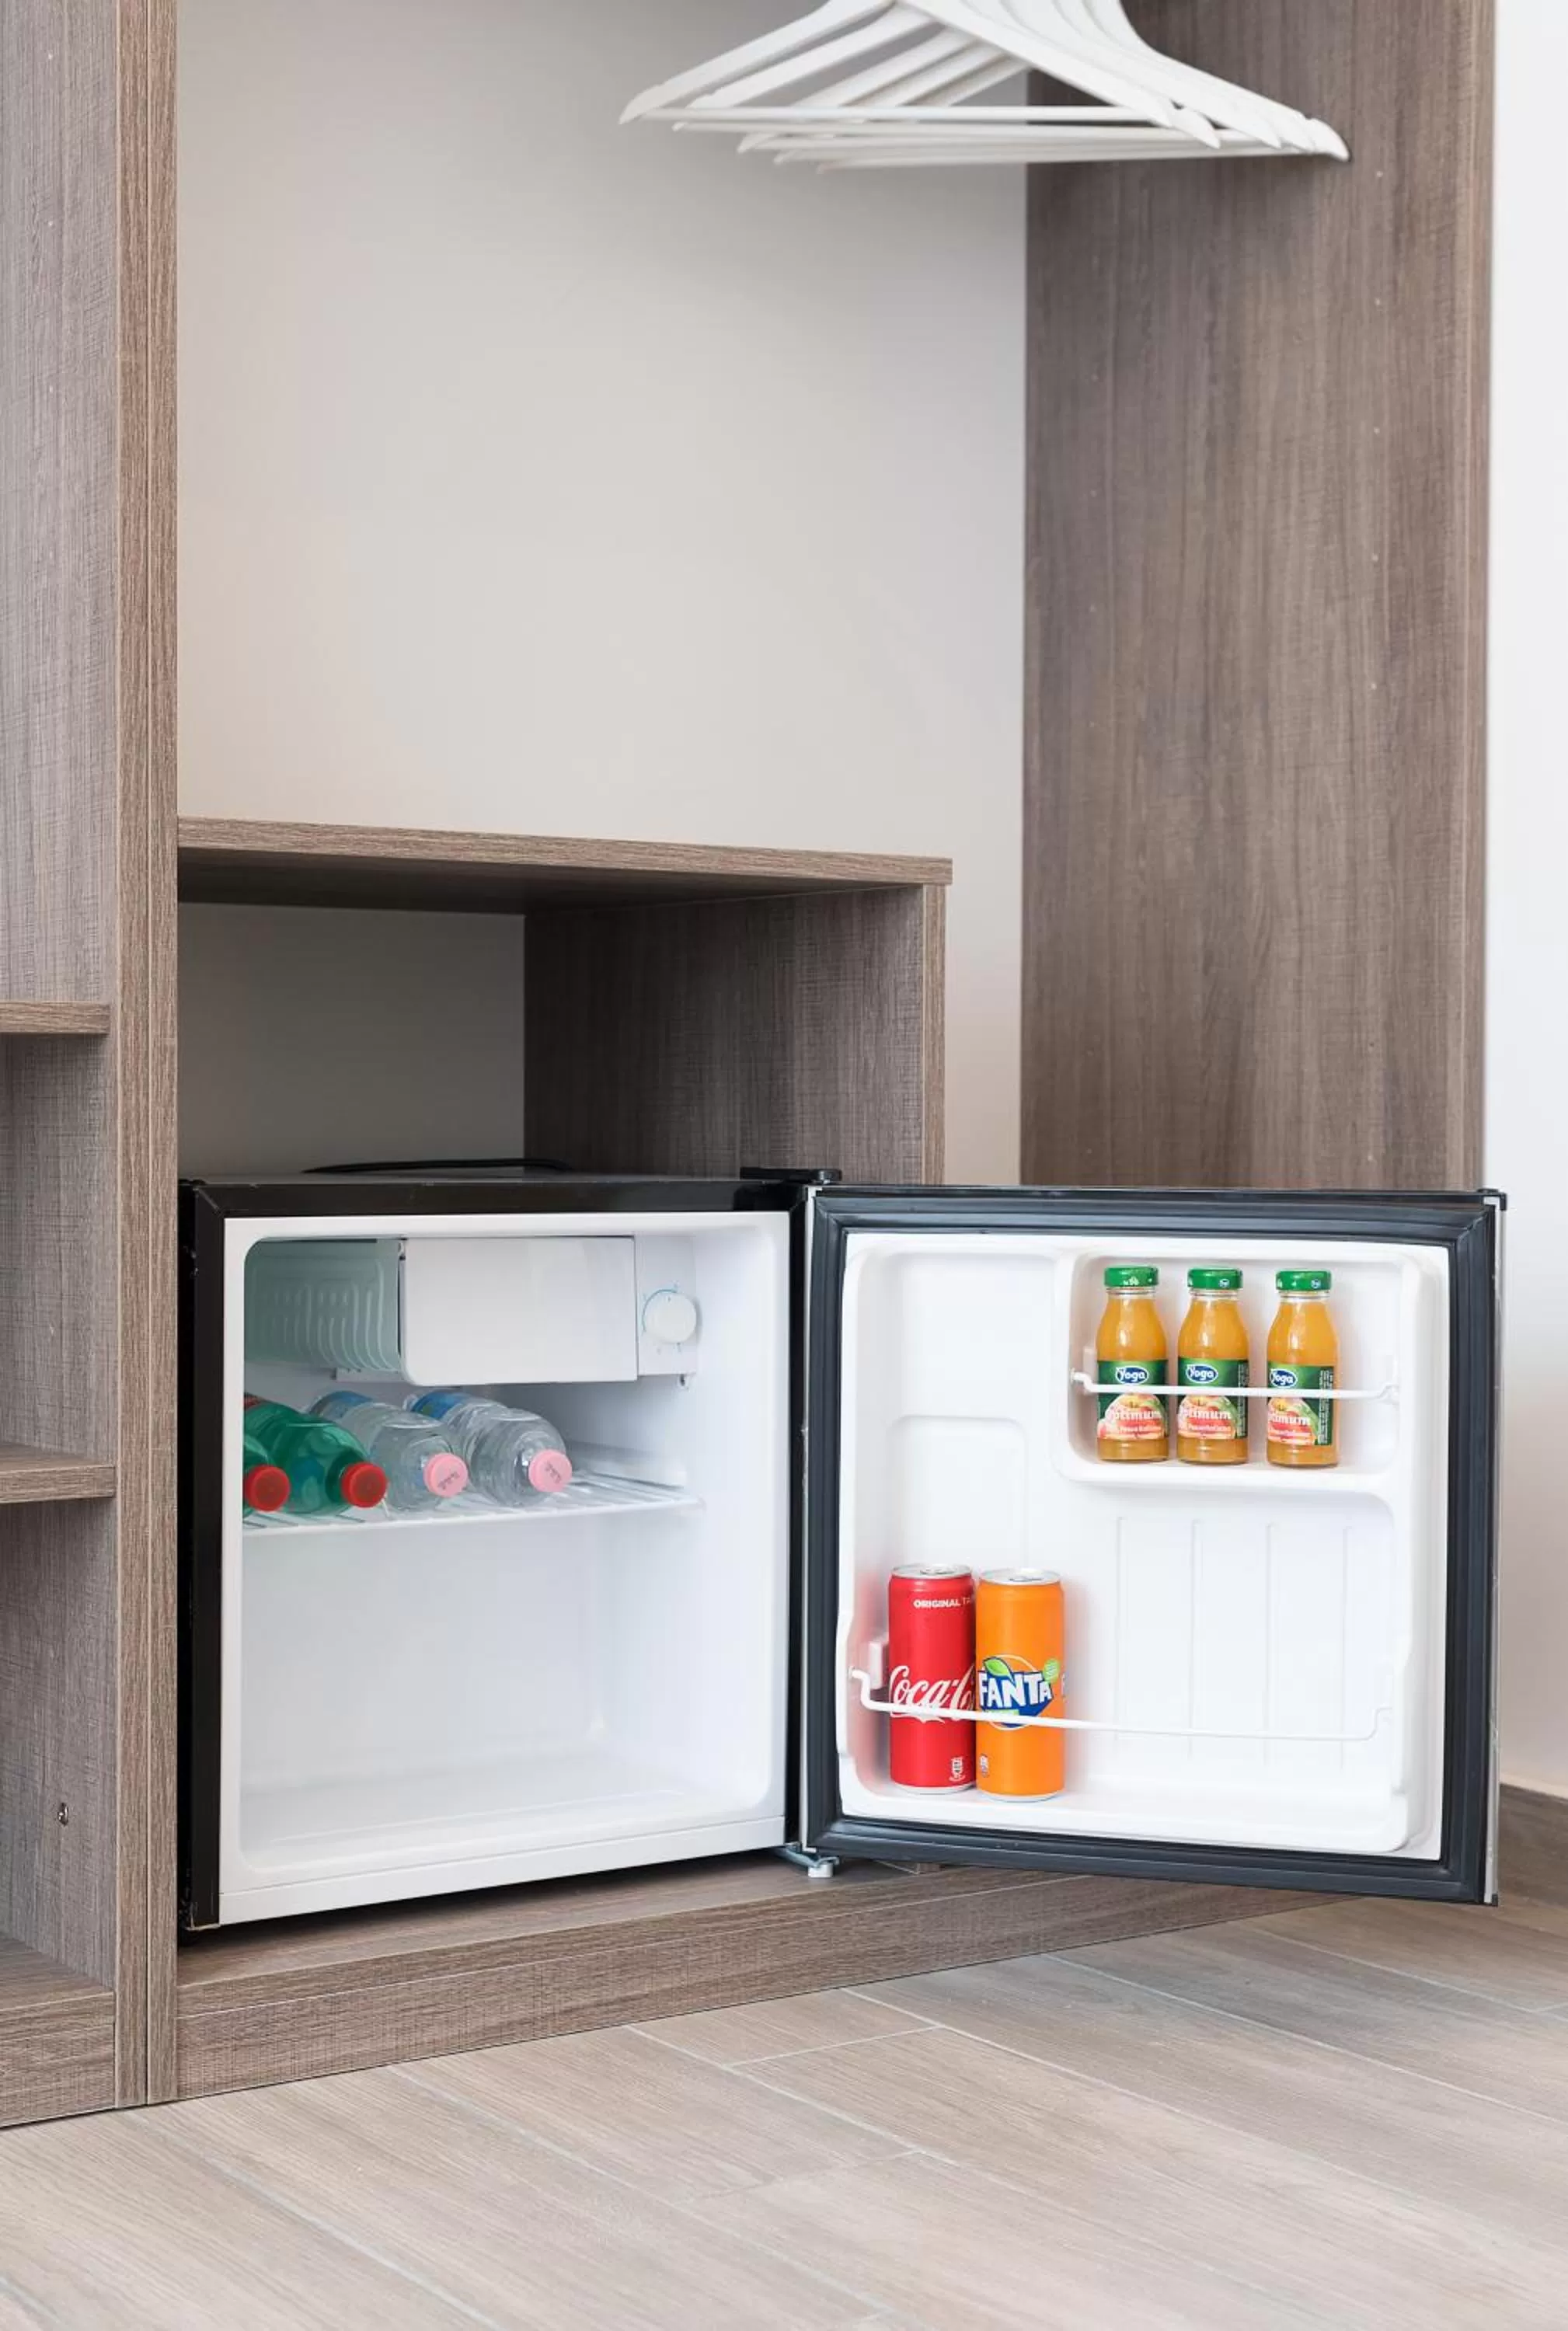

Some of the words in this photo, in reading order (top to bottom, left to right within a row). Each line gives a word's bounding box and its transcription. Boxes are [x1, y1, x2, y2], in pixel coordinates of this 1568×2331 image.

[1118, 1367, 1146, 1382] Yoga
[1189, 1365, 1215, 1381] Yoga
[1272, 1370, 1294, 1385] Yoga
[913, 1598, 961, 1609] ORIGINAL
[978, 1671, 1053, 1708] FANTA
